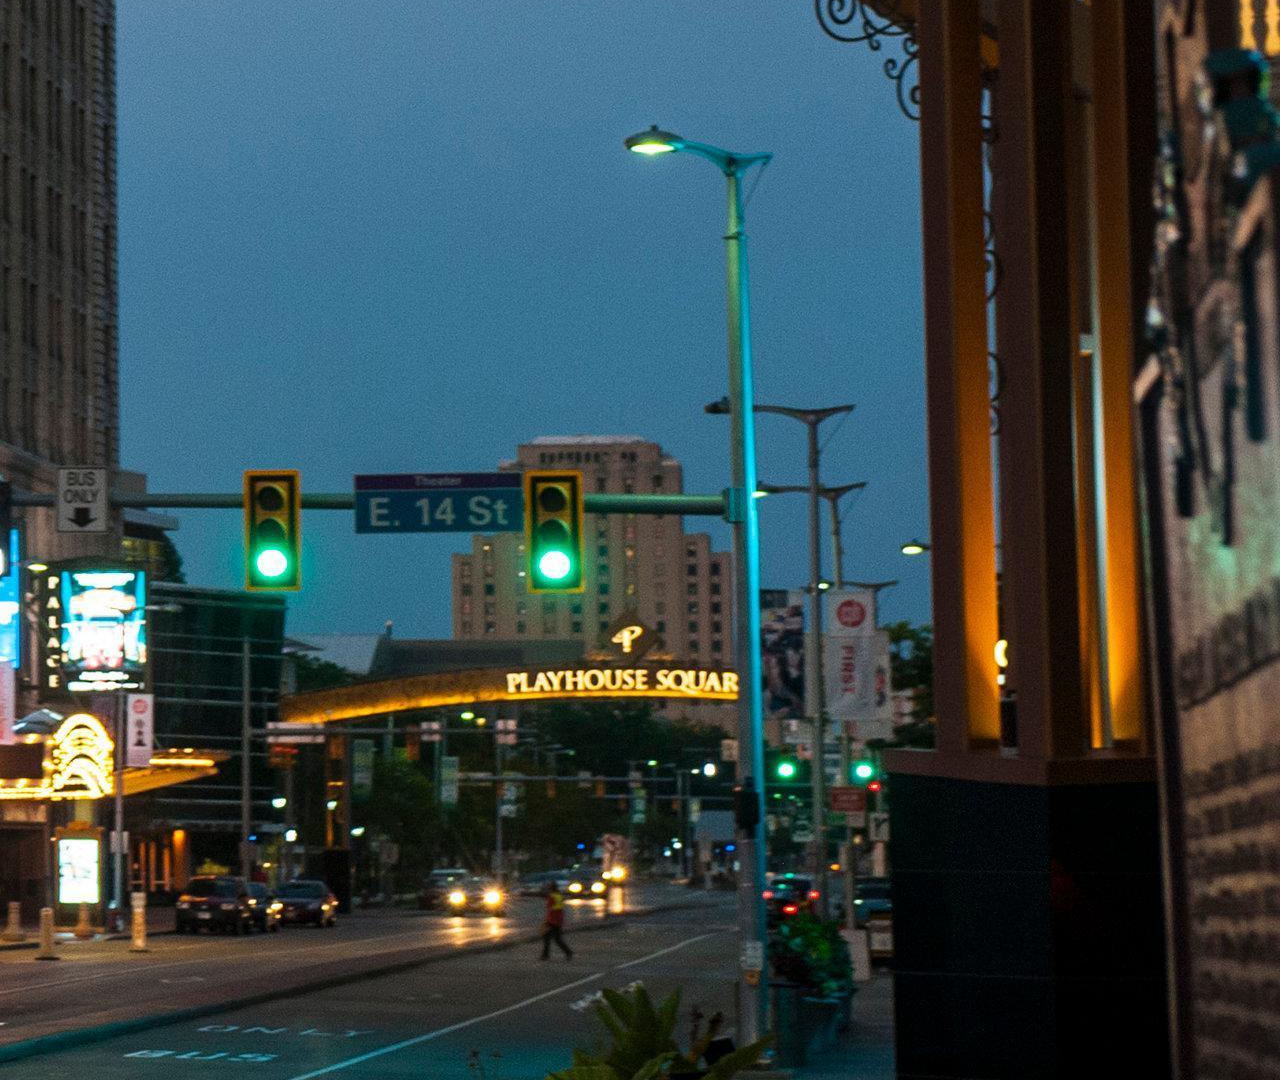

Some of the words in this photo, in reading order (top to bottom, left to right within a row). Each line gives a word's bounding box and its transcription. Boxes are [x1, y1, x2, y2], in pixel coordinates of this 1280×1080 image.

[66, 471, 96, 487] BUS
[63, 489, 99, 504] ONLY
[369, 497, 400, 528] E.
[415, 497, 456, 526] 14
[467, 495, 509, 526] St
[45, 575, 61, 689] PALACE
[506, 669, 649, 693] PLAYHOUSE
[655, 669, 740, 695] SQUAR
[123, 1050, 281, 1062] BUS
